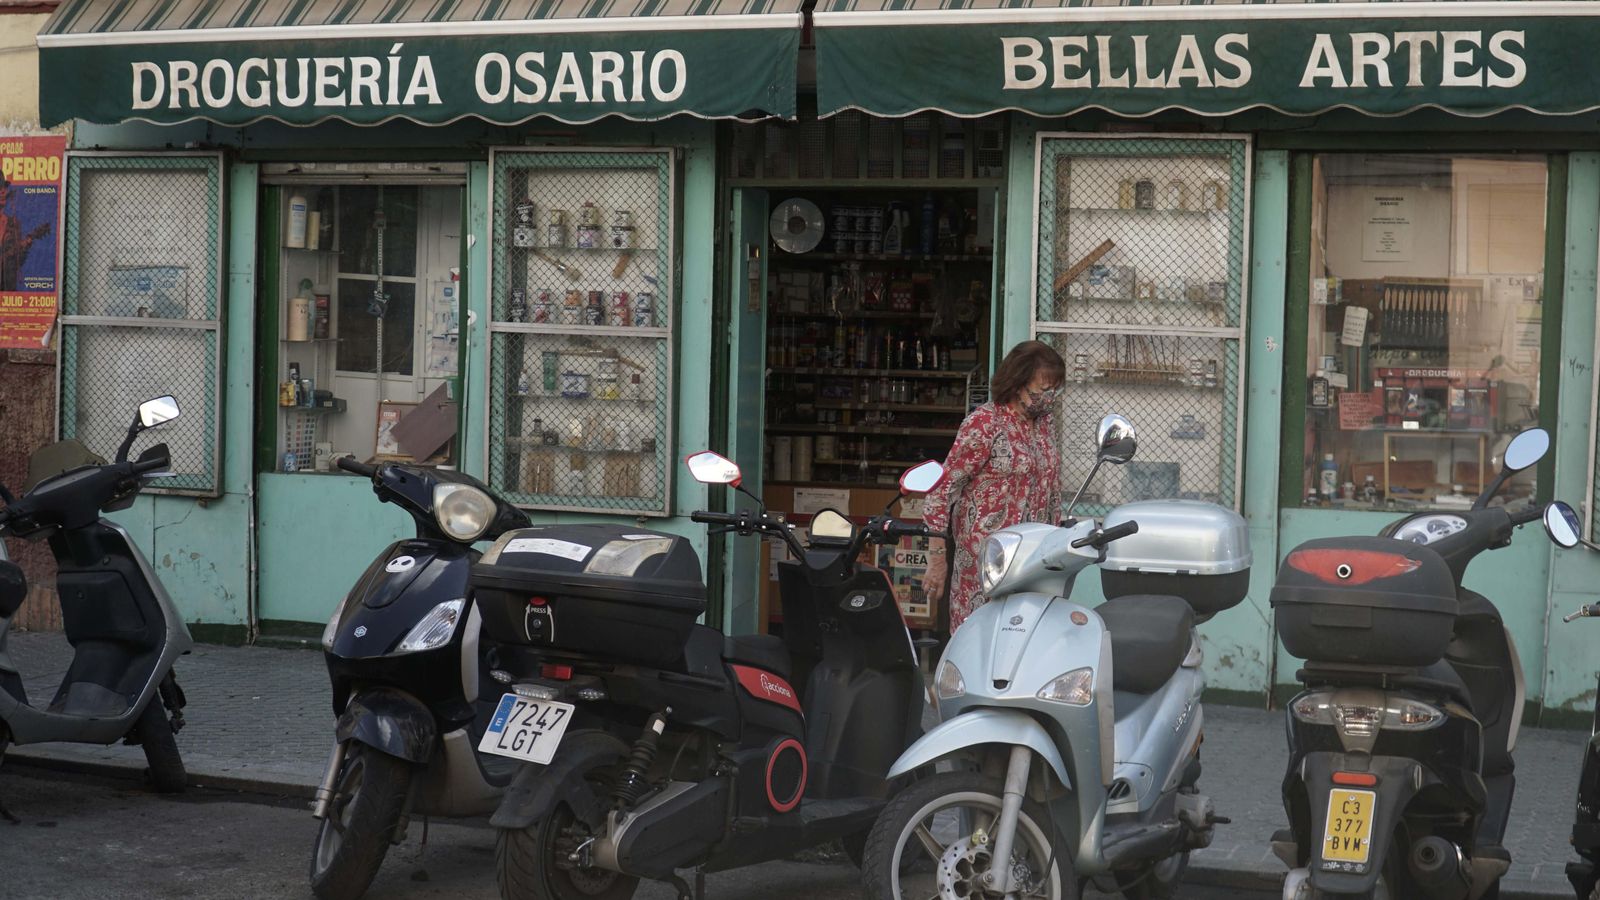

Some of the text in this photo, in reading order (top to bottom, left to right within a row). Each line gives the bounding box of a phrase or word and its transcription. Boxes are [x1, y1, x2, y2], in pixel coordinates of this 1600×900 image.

[1000, 30, 1527, 90] BELLAS ARTES
[130, 43, 687, 110] DROGUERÍA OSARIO
[2, 156, 60, 181] PERRO
[2, 295, 23, 307] JULIO
[29, 295, 56, 307] 21:00H
[767, 682, 792, 699] acciona
[508, 701, 568, 731] 7247
[497, 726, 543, 755] LGT
[1334, 818, 1363, 833] 377
